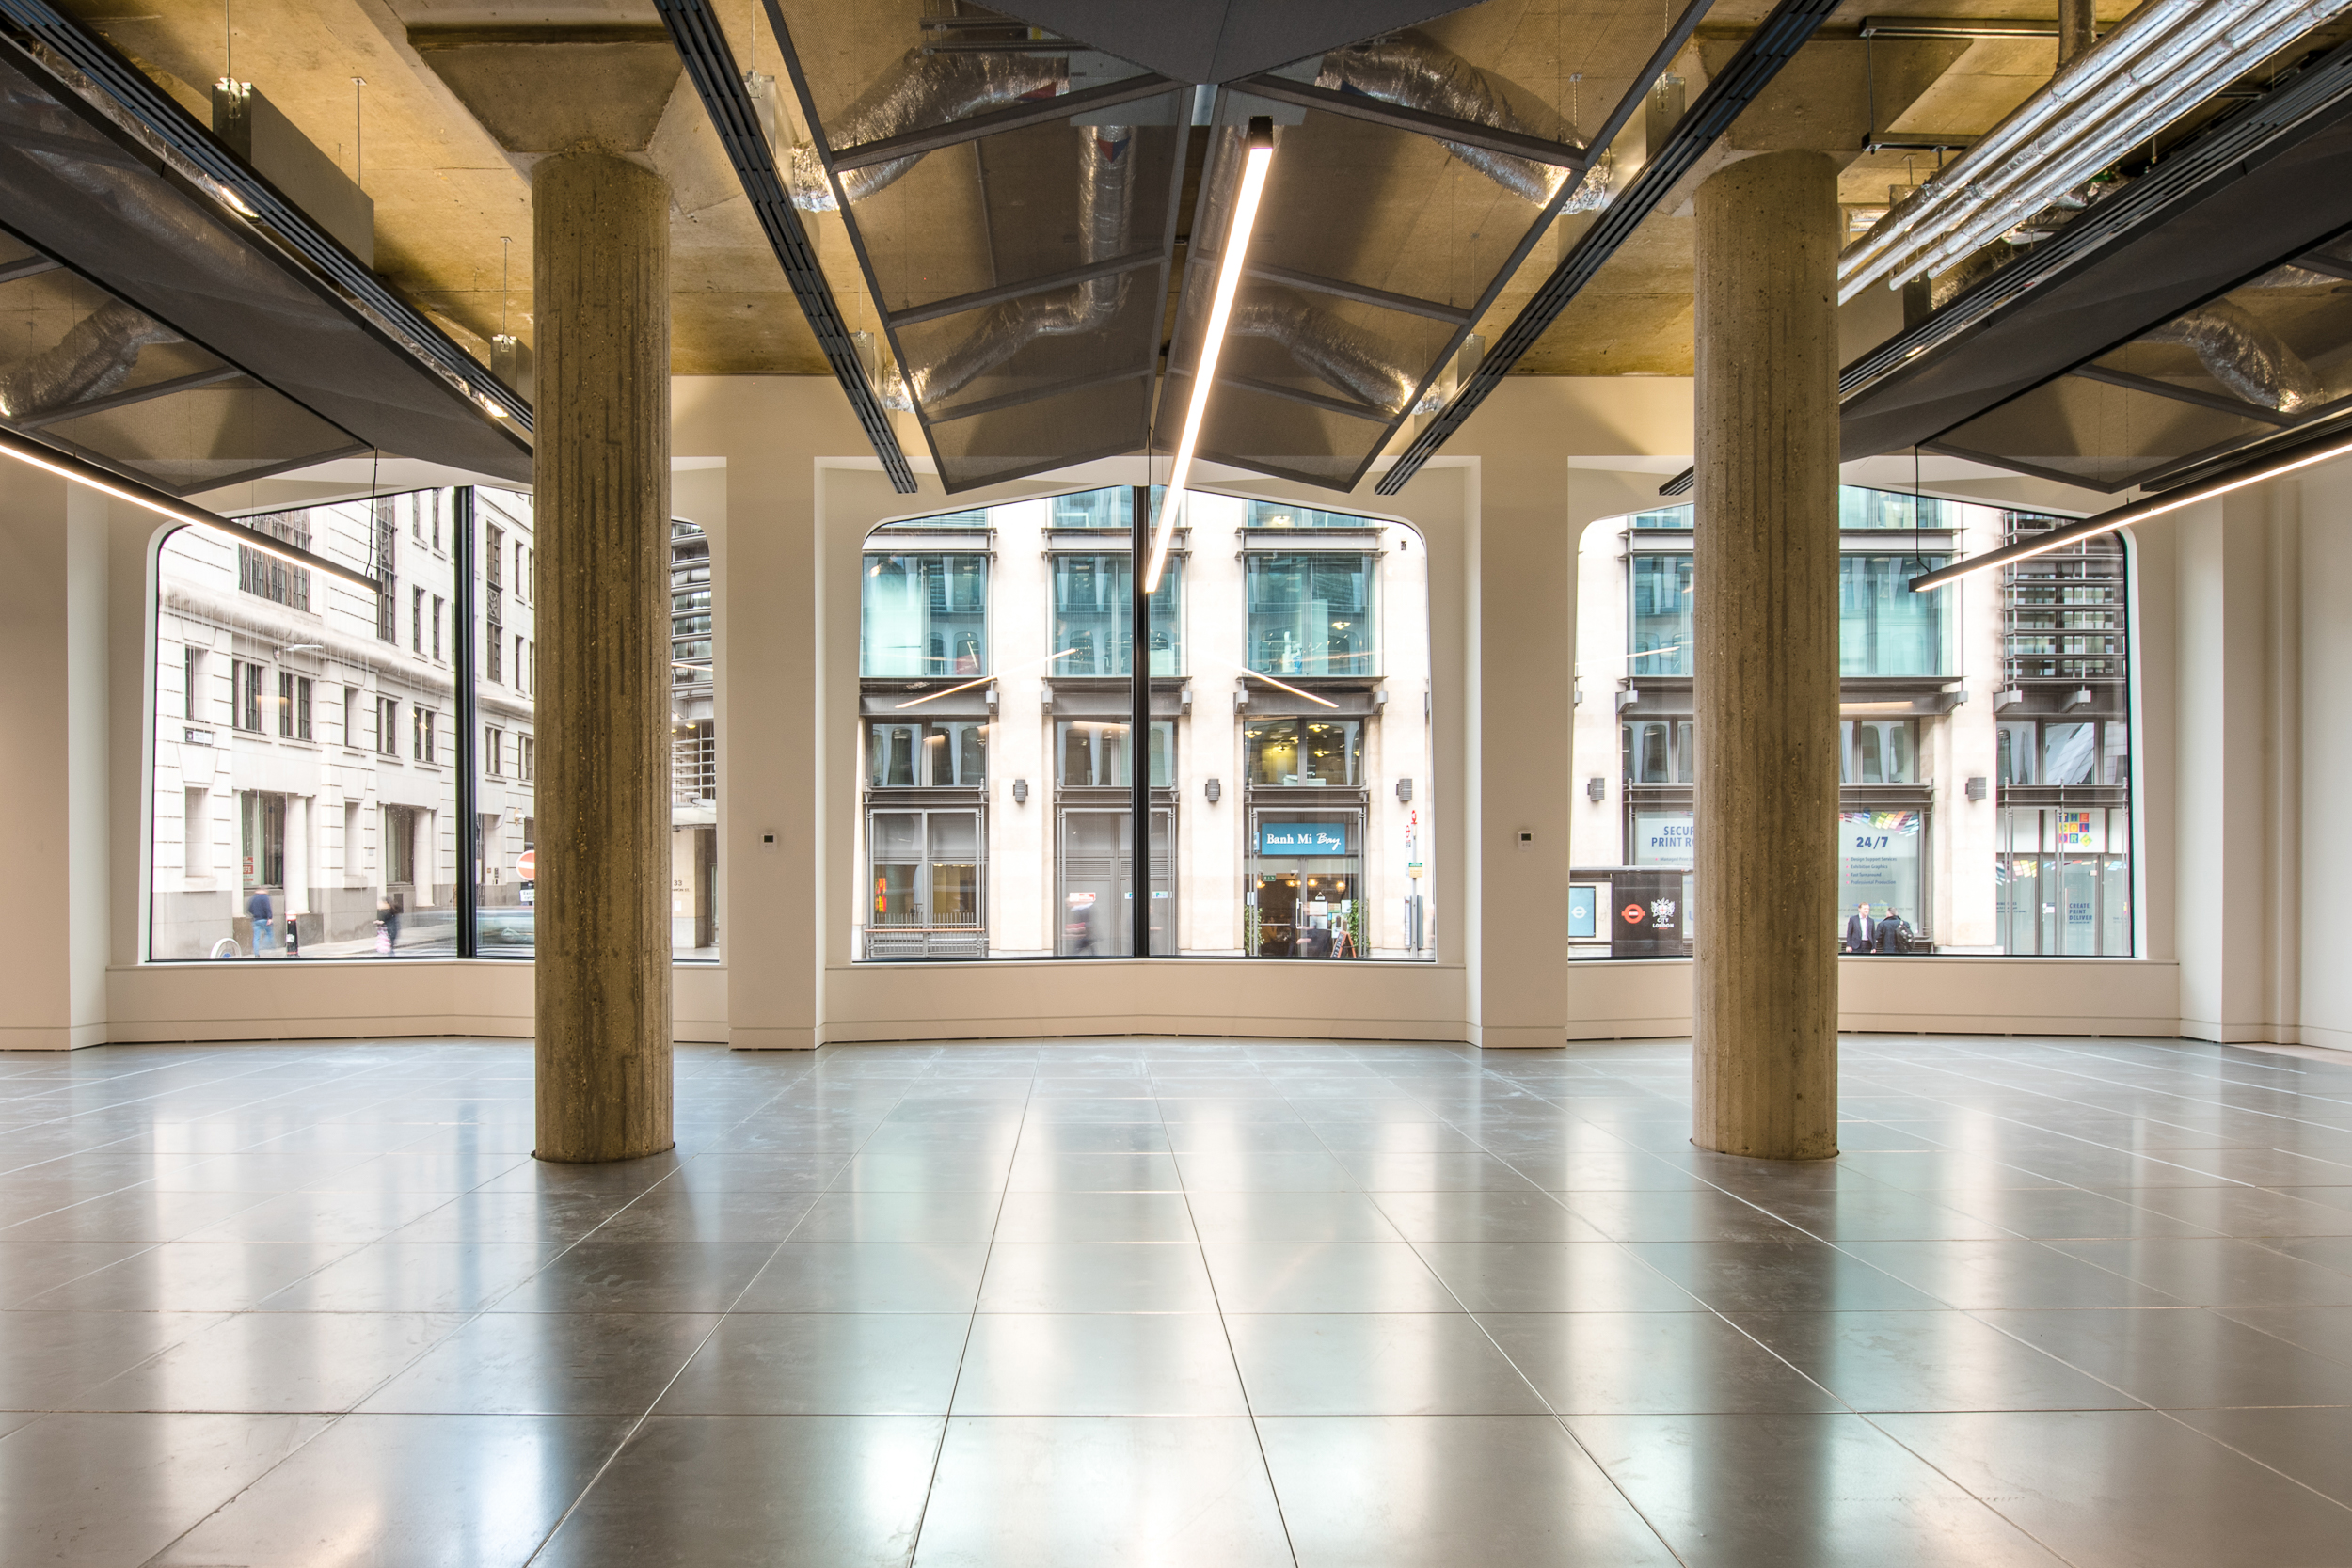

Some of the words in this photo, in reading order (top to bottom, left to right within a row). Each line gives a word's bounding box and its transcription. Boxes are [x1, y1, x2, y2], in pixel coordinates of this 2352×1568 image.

[1266, 833, 1294, 844] Banh
[1297, 833, 1312, 844] Mi
[1316, 832, 1341, 851] Bay
[1651, 837, 1682, 847] PRINT
[1856, 836, 1889, 849] 24/7
